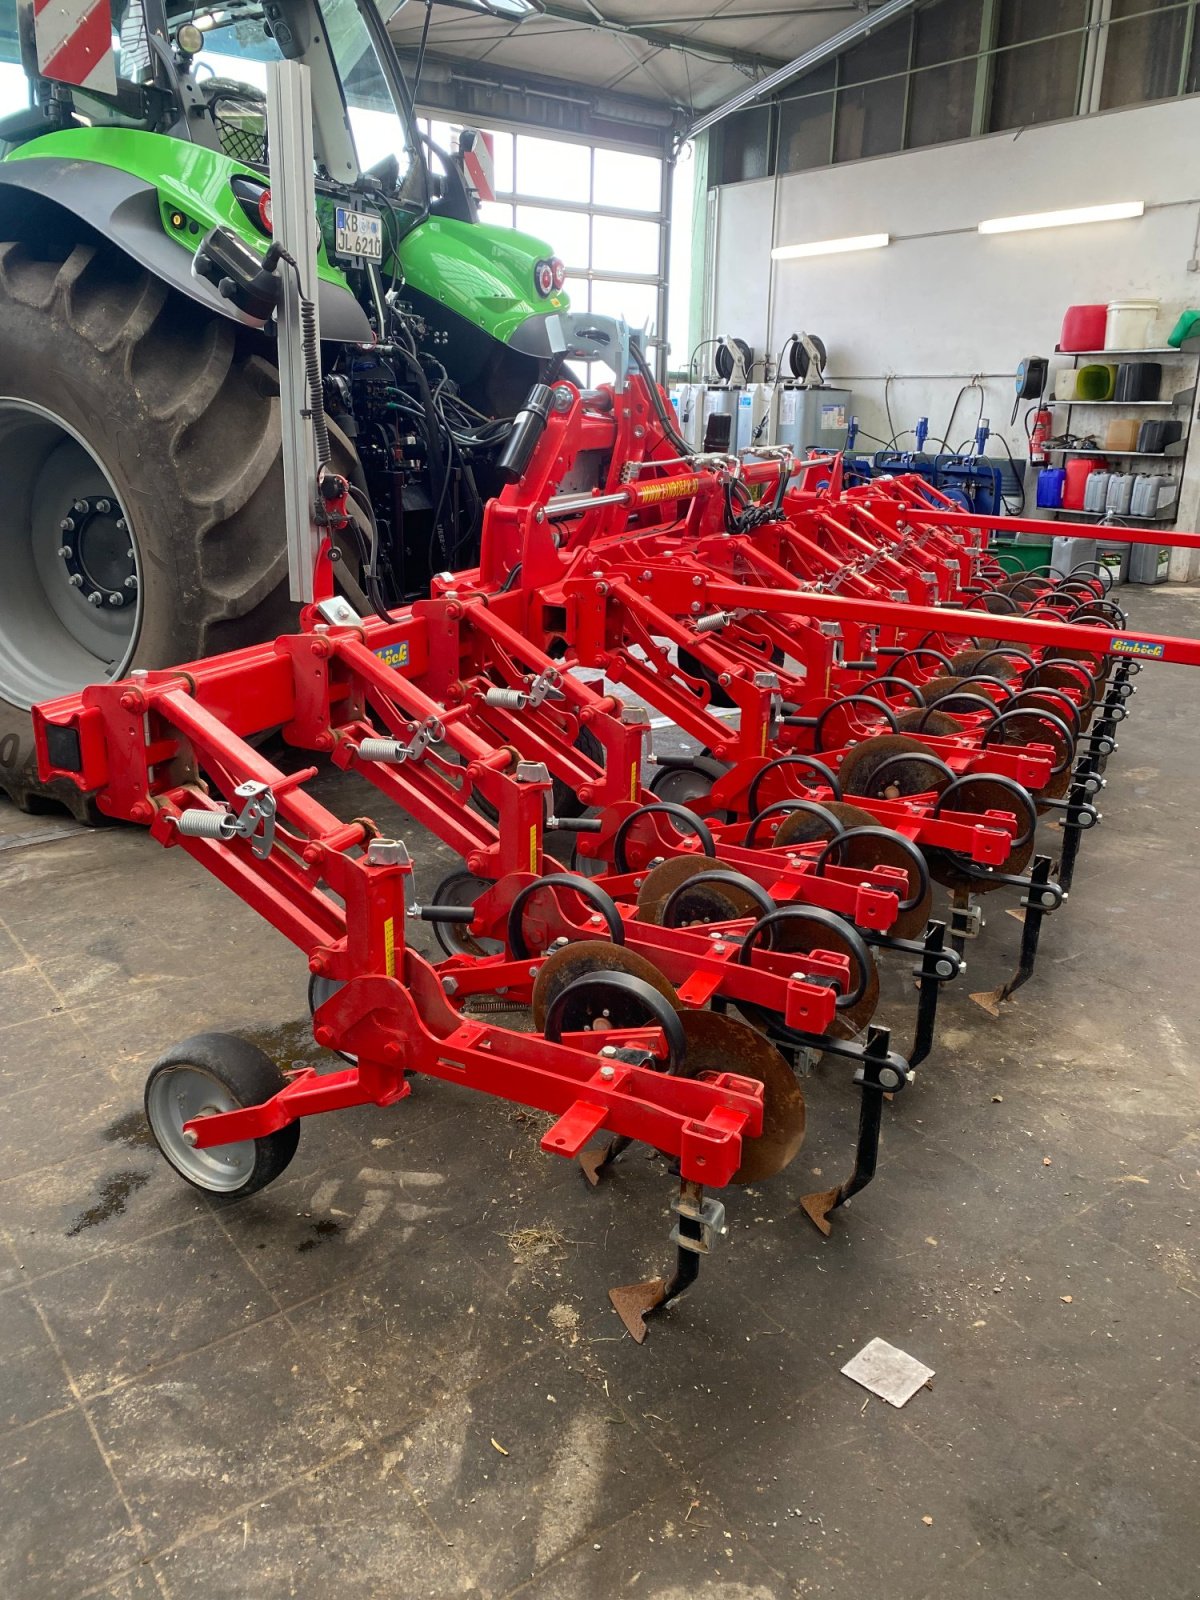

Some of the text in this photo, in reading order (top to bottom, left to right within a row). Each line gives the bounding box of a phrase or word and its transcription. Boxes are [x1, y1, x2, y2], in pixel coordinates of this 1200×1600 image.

[344, 212, 358, 233] KB
[338, 231, 381, 257] JL 6210
[1112, 640, 1163, 656] Einböck
